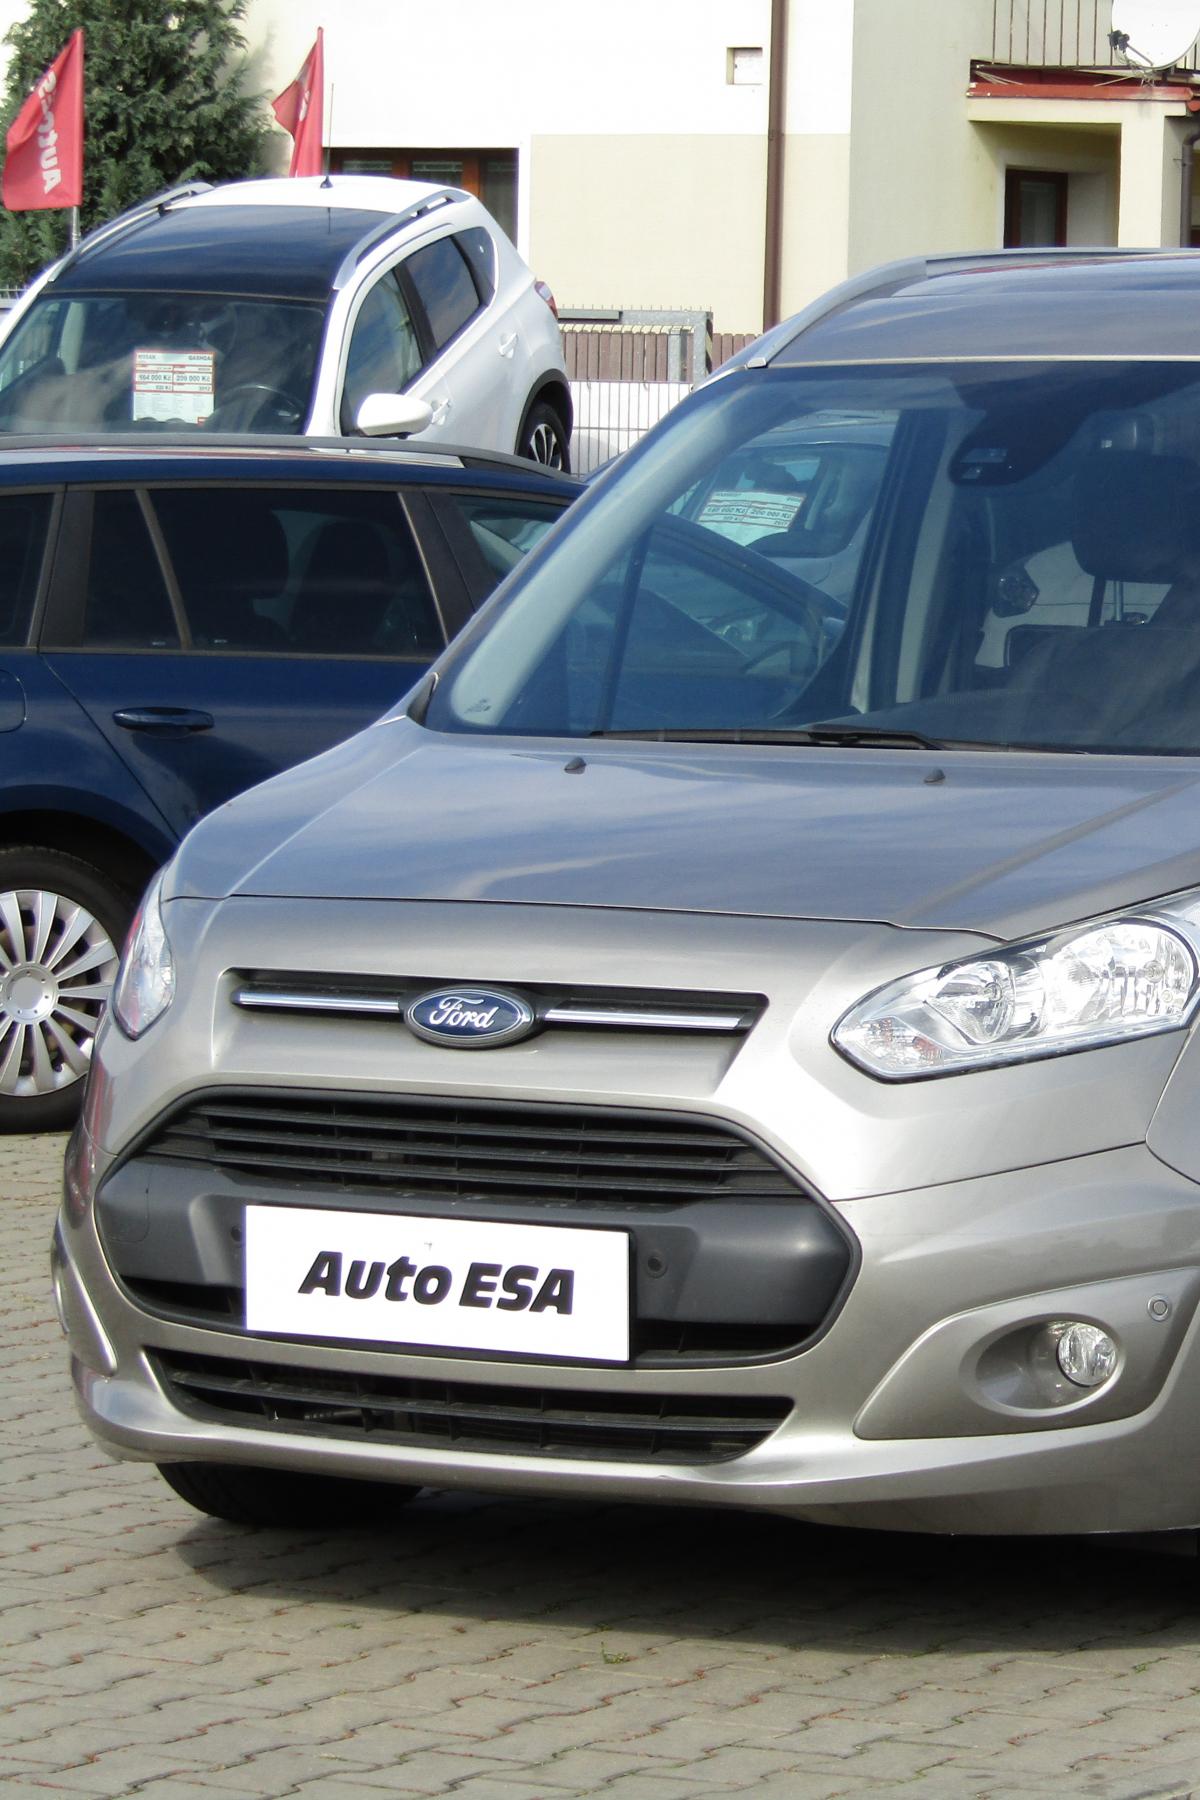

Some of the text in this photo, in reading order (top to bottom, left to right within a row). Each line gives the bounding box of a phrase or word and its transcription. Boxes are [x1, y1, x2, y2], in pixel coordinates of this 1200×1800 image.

[429, 996, 499, 1029] Ford
[297, 1250, 575, 1315] Auto ESA
